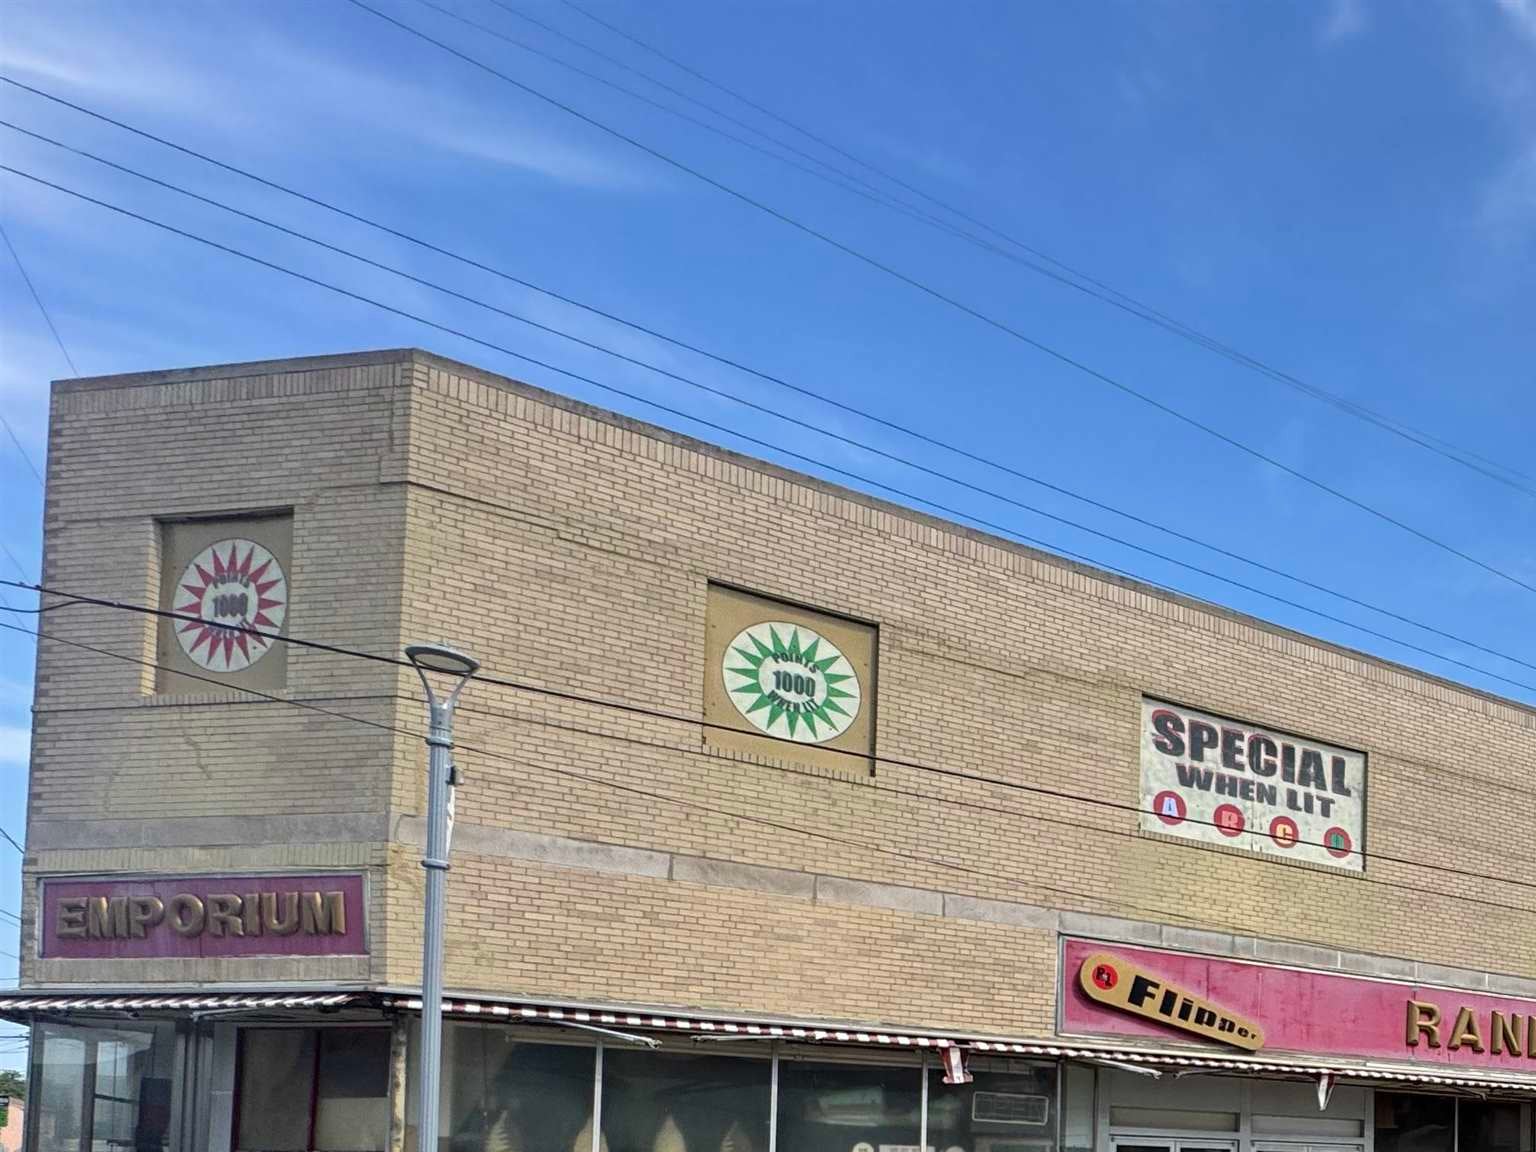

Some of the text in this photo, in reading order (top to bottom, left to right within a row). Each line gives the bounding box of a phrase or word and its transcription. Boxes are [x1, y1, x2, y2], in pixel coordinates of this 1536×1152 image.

[770, 651, 820, 674] POINTS
[772, 670, 816, 698] 1000
[767, 689, 820, 713] WHEN LIT
[1151, 709, 1352, 798] SPECIAL
[1175, 762, 1336, 819] WHEN LIT
[1162, 797, 1179, 818] A
[1276, 823, 1293, 843] C
[55, 891, 347, 940] EMPORIUM
[1127, 974, 1257, 1040] Flipper
